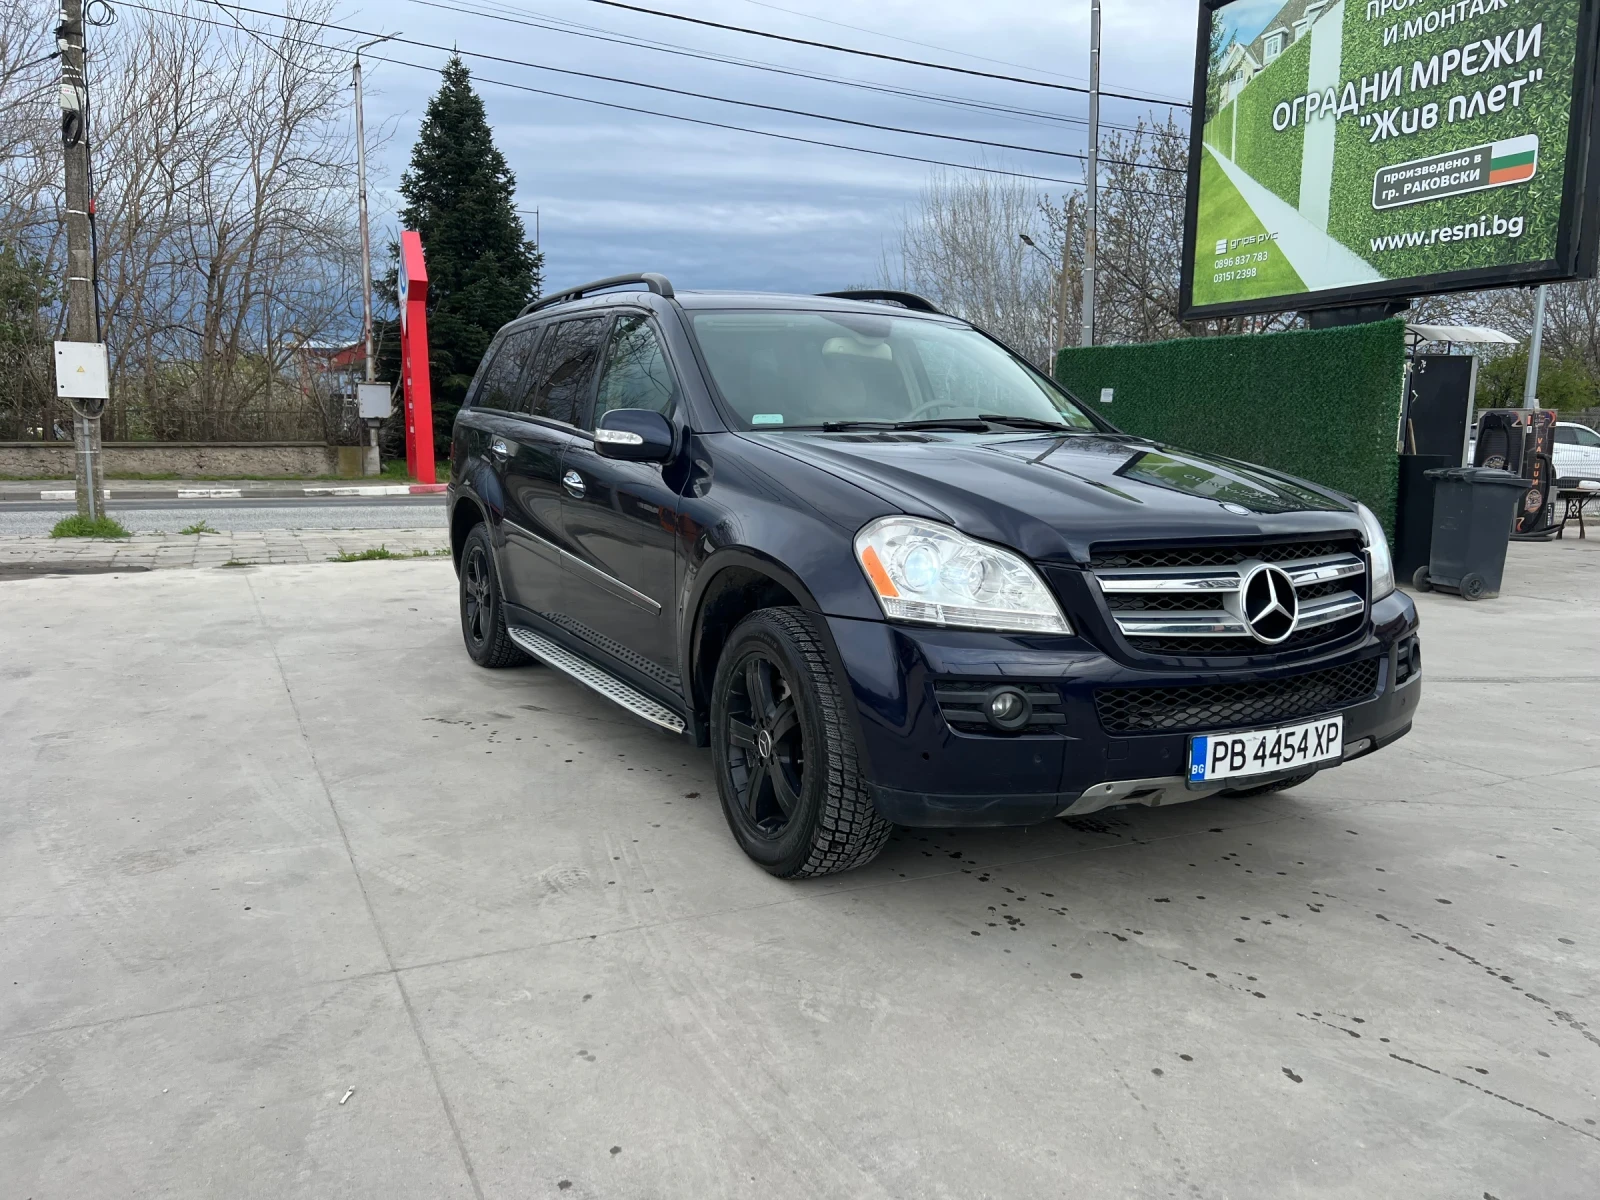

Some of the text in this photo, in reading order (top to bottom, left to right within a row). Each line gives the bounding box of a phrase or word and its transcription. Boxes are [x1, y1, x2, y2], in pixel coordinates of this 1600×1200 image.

[1383, 24, 1398, 47] И
[1272, 22, 1543, 132] ОГРАДНИ МРЕЖИ
[1383, 156, 1470, 185] произведено
[1382, 168, 1481, 201] гр. РАКОВСКИ
[1230, 232, 1278, 250] grips pvc
[1370, 214, 1524, 252] www.resni.bg
[1214, 251, 1268, 269] 0896 837 783
[1213, 267, 1257, 283] 03151 2398
[1253, 728, 1309, 768] 4454
[1191, 763, 1205, 775] BG
